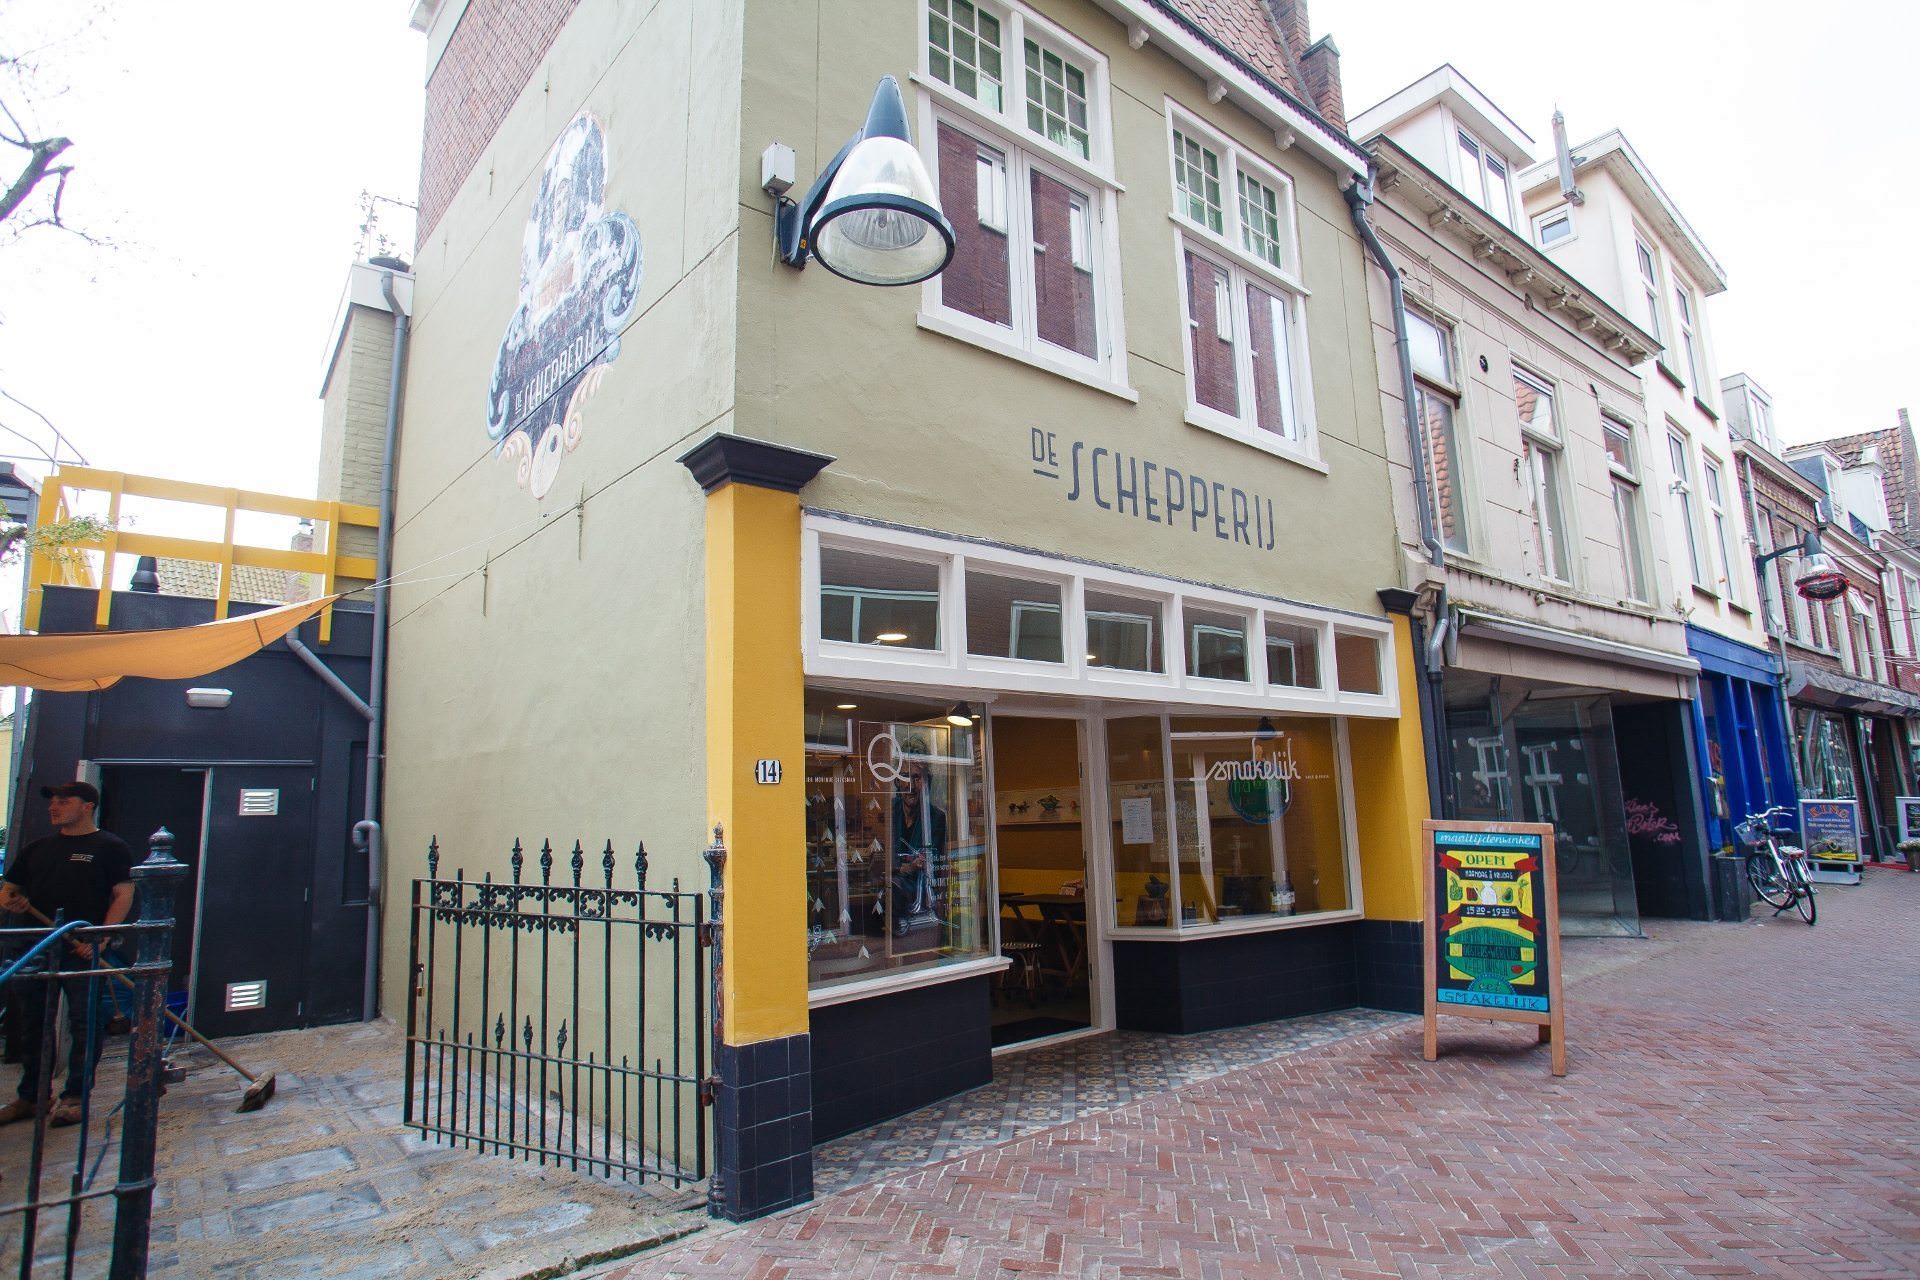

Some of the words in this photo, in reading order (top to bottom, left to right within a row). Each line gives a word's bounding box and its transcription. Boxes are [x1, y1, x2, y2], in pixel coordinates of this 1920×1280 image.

[523, 322, 595, 418] SCHEPPERIJ
[1031, 426, 1059, 468] DE
[1067, 440, 1276, 551] SCHEPPERIJ
[761, 760, 777, 783] 14
[867, 732, 911, 783] Q
[1190, 737, 1302, 803] smakelijk
[1465, 854, 1506, 866] OPEN
